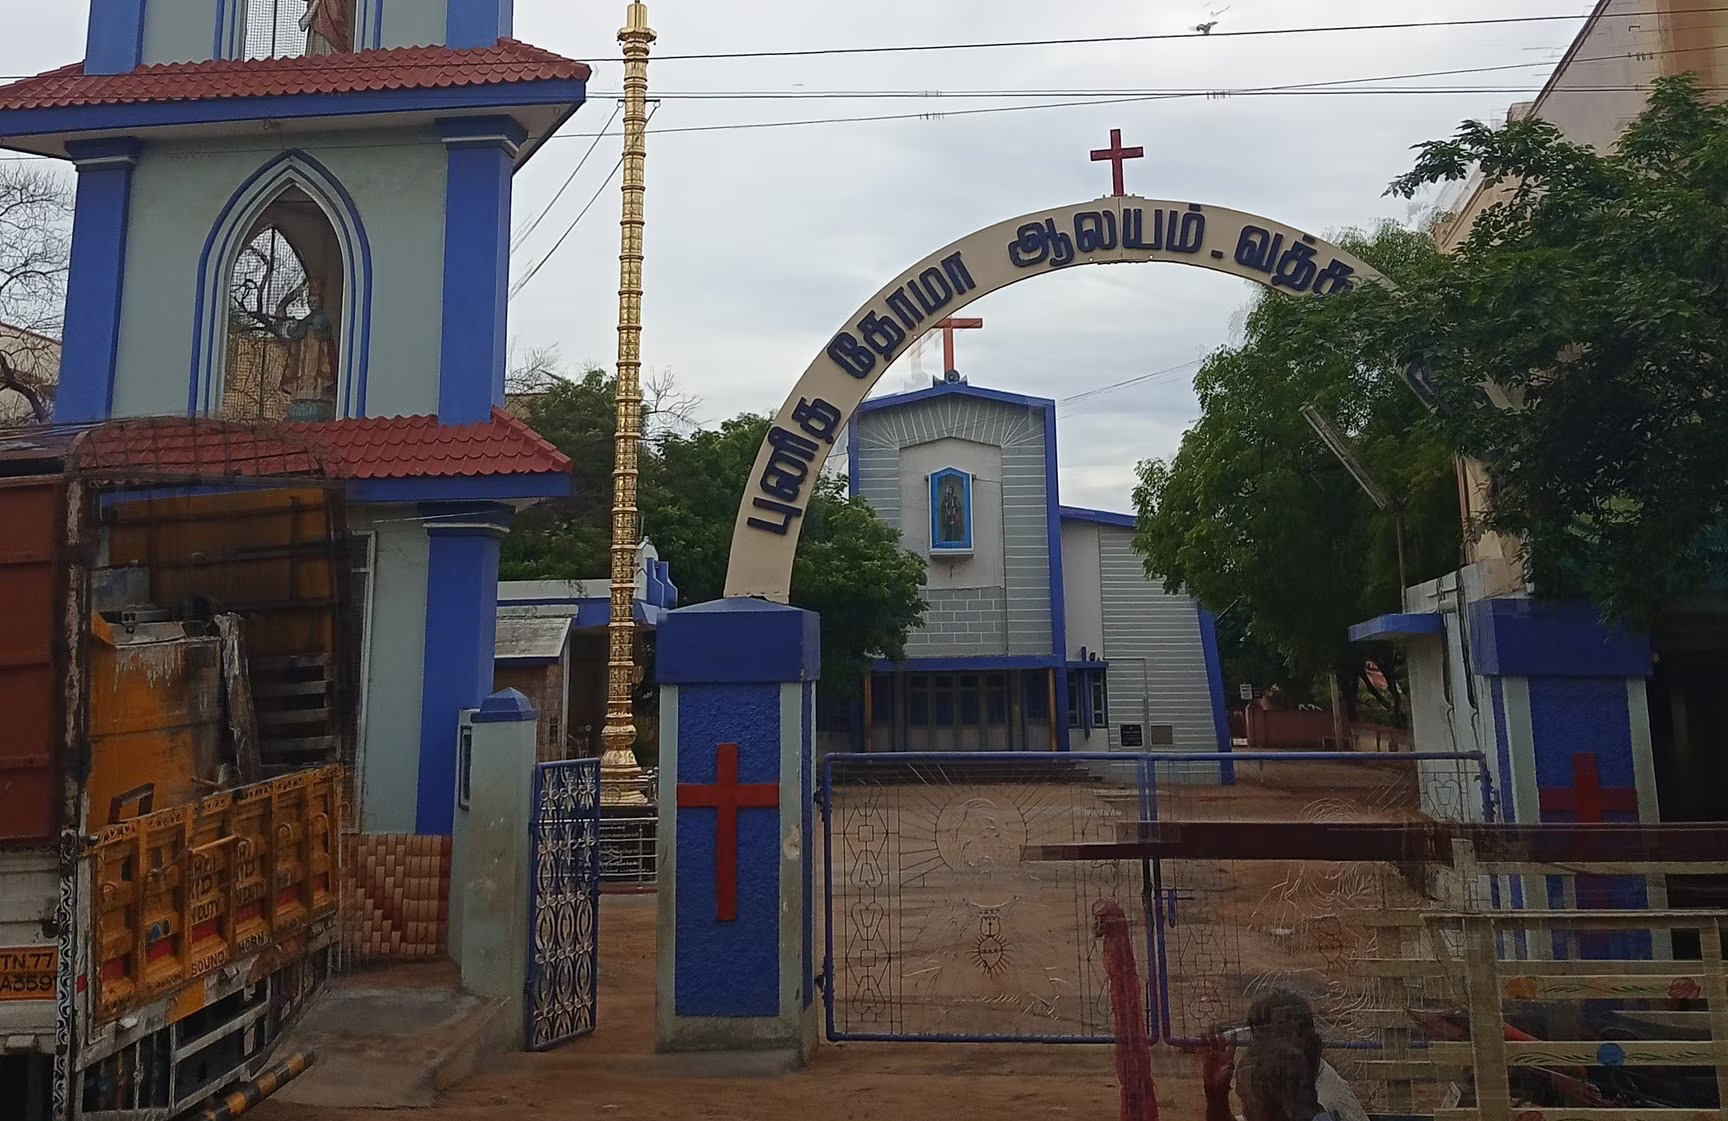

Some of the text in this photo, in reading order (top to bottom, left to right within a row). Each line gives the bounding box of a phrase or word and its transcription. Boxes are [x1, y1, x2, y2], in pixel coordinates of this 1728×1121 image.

[746, 396, 842, 536] புனித
[826, 250, 977, 380] தோமா
[191, 932, 265, 976] SOUND HORN
